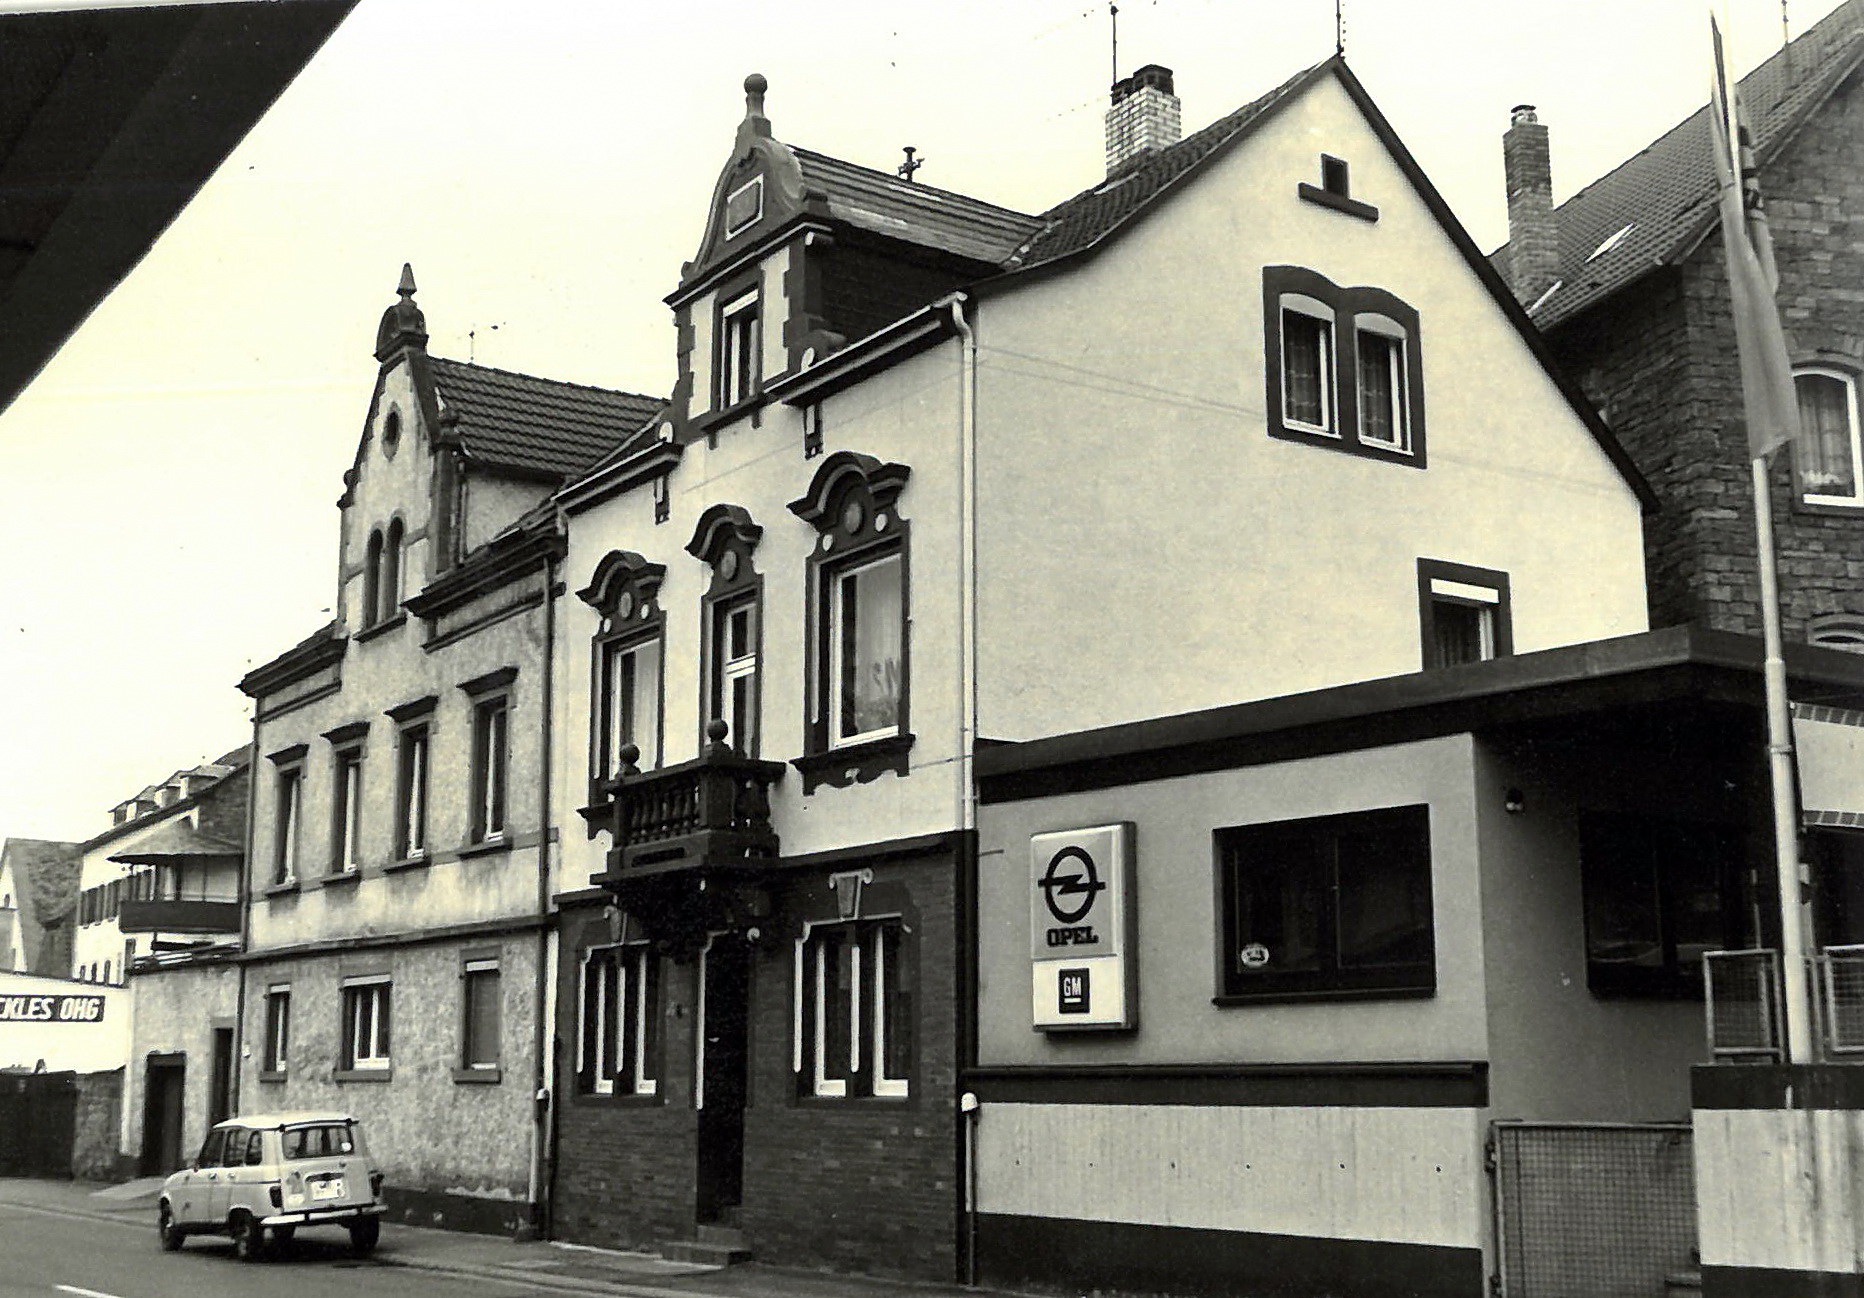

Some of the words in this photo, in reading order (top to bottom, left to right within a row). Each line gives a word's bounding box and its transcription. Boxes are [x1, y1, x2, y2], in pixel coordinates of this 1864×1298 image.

[1046, 926, 1099, 947] OPEL
[1063, 976, 1082, 997] GM
[60, 997, 101, 1020] OHG
